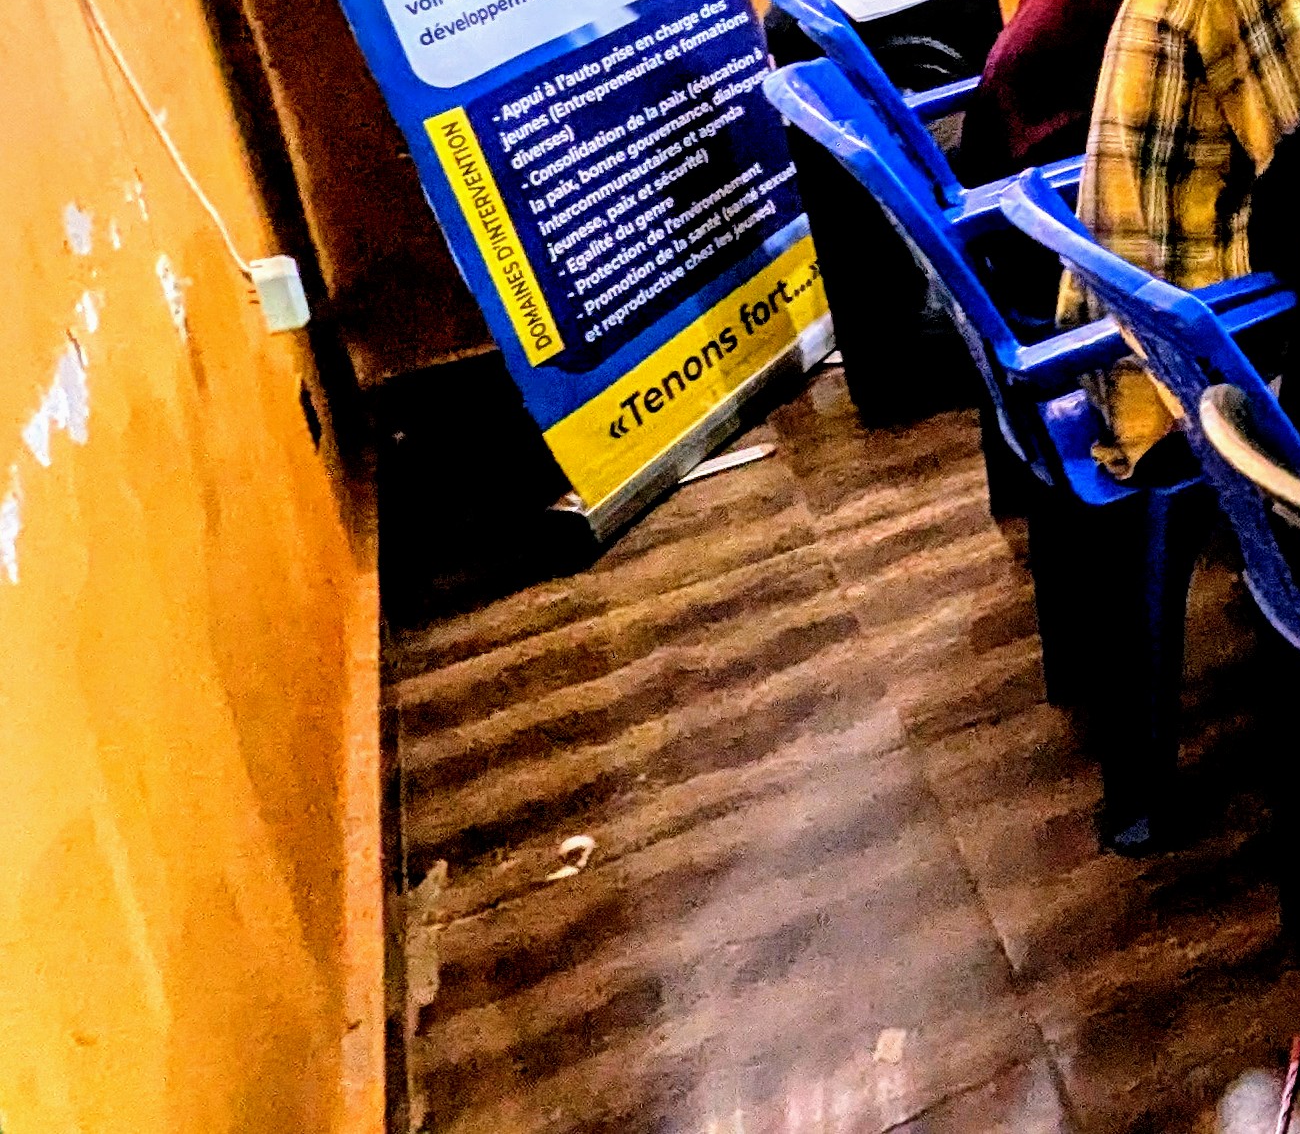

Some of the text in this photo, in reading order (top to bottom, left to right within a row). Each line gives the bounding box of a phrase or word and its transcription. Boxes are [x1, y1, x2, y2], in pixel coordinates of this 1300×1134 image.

[499, 11, 749, 153] jeunes (Entrepreneuriat et formations
[501, 85, 545, 121] Appui
[543, 81, 557, 97] à
[554, 62, 600, 91] l'auto
[601, 44, 635, 72] prise
[635, 33, 655, 51] en
[655, 11, 700, 42] charge
[700, 0, 727, 19] des
[511, 123, 575, 170] diverses)
[528, 198, 546, 215] la
[545, 179, 580, 208] paix,
[577, 149, 628, 184] bonne
[627, 102, 714, 159] gouvernance,
[529, 124, 627, 186] Consolidation
[626, 113, 646, 131] de
[643, 105, 659, 121] la
[658, 88, 688, 116] paix
[686, 58, 755, 99] (éducation
[537, 105, 745, 237] intercommunautaires et agenda
[441, 120, 553, 351] DOMAINES D'INTERVENTION
[565, 232, 615, 274] Egalité
[615, 221, 635, 241] du
[634, 196, 675, 231] genre
[574, 241, 647, 296] Protection
[646, 228, 666, 246] de
[664, 161, 764, 235] l'environnement
[606, 194, 638, 223] paix
[637, 183, 655, 201] et
[653, 147, 709, 191] sécurité)
[583, 261, 656, 316] Promotion
[655, 247, 674, 266] de
[671, 238, 689, 253] la
[688, 212, 722, 244] santé
[584, 324, 603, 343] et
[601, 266, 686, 331] reproductive
[684, 243, 715, 271] chez
